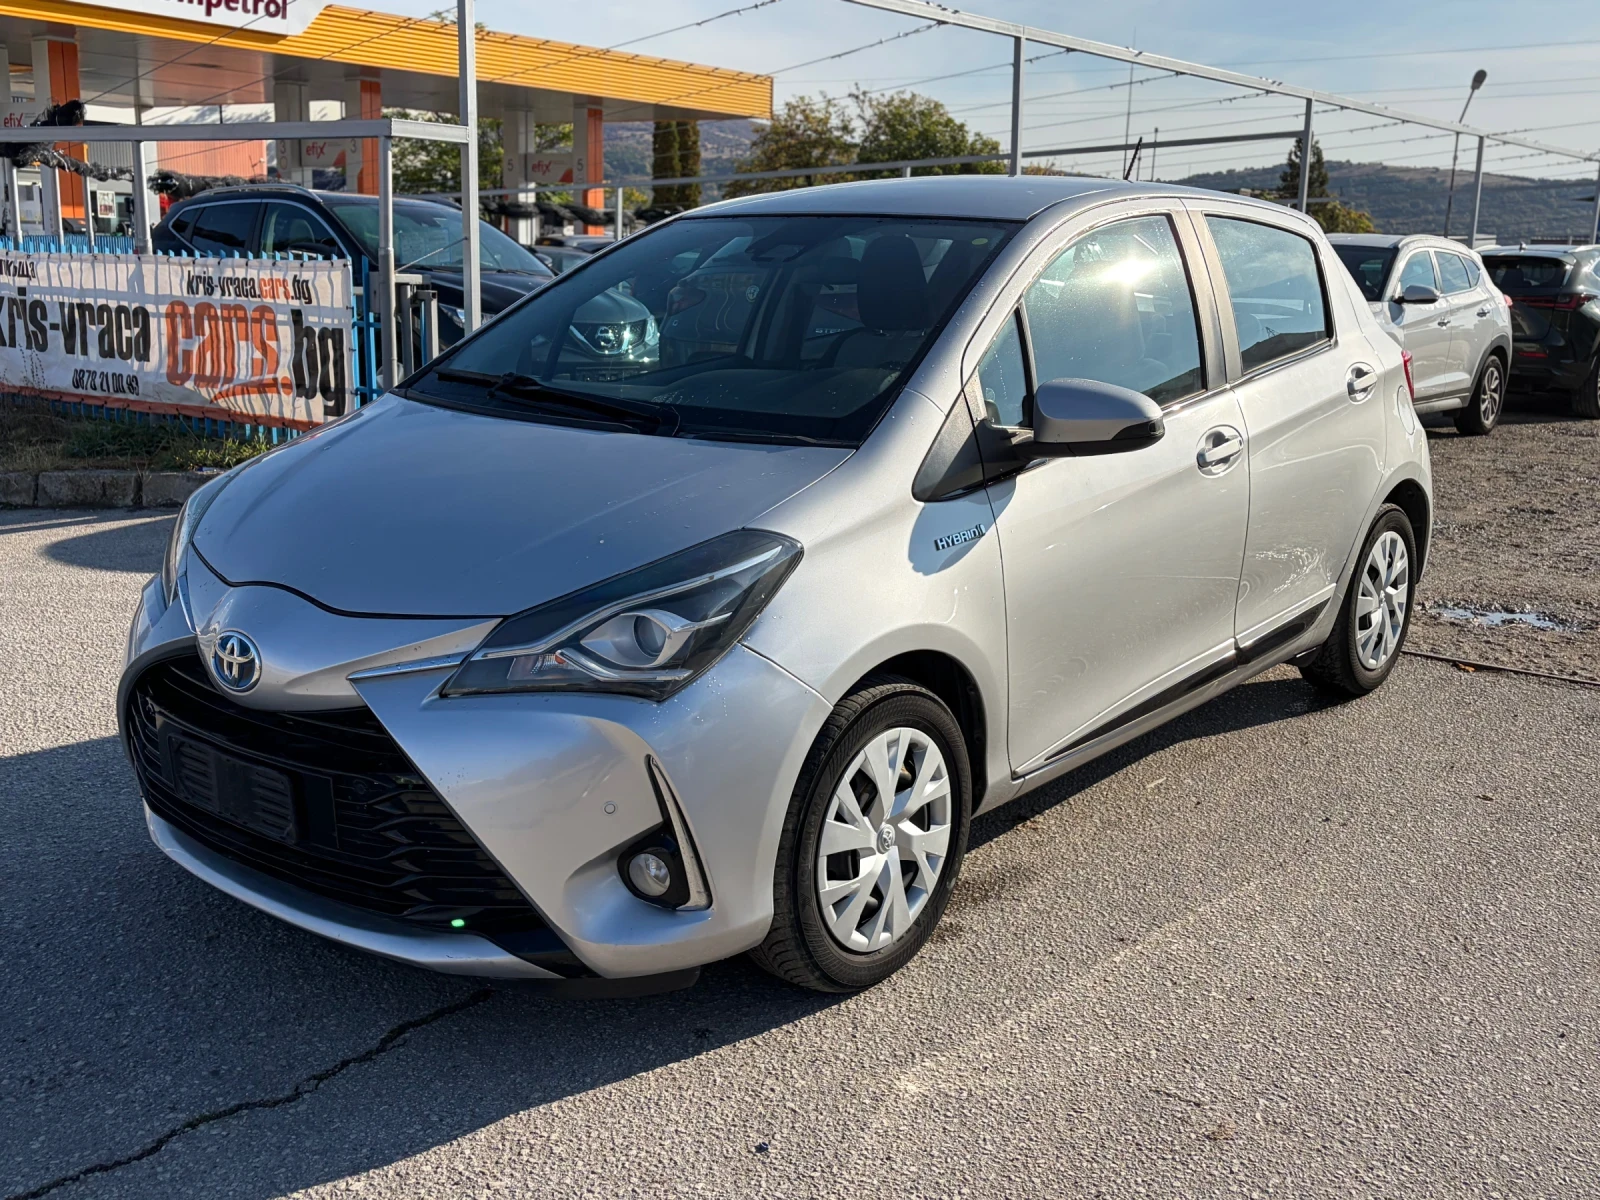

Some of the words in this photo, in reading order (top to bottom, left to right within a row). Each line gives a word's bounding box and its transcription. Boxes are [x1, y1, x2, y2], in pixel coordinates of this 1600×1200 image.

[162, 0, 288, 20] petrol
[305, 141, 327, 160] efix
[507, 158, 514, 173] 5
[531, 160, 553, 177] efix
[576, 158, 584, 172] 5
[187, 269, 313, 305] kris-vraca.cars.bg
[72, 368, 97, 391] 0878
[99, 371, 110, 393] 21
[111, 372, 126, 394] 00
[936, 526, 981, 550] HYBRID
